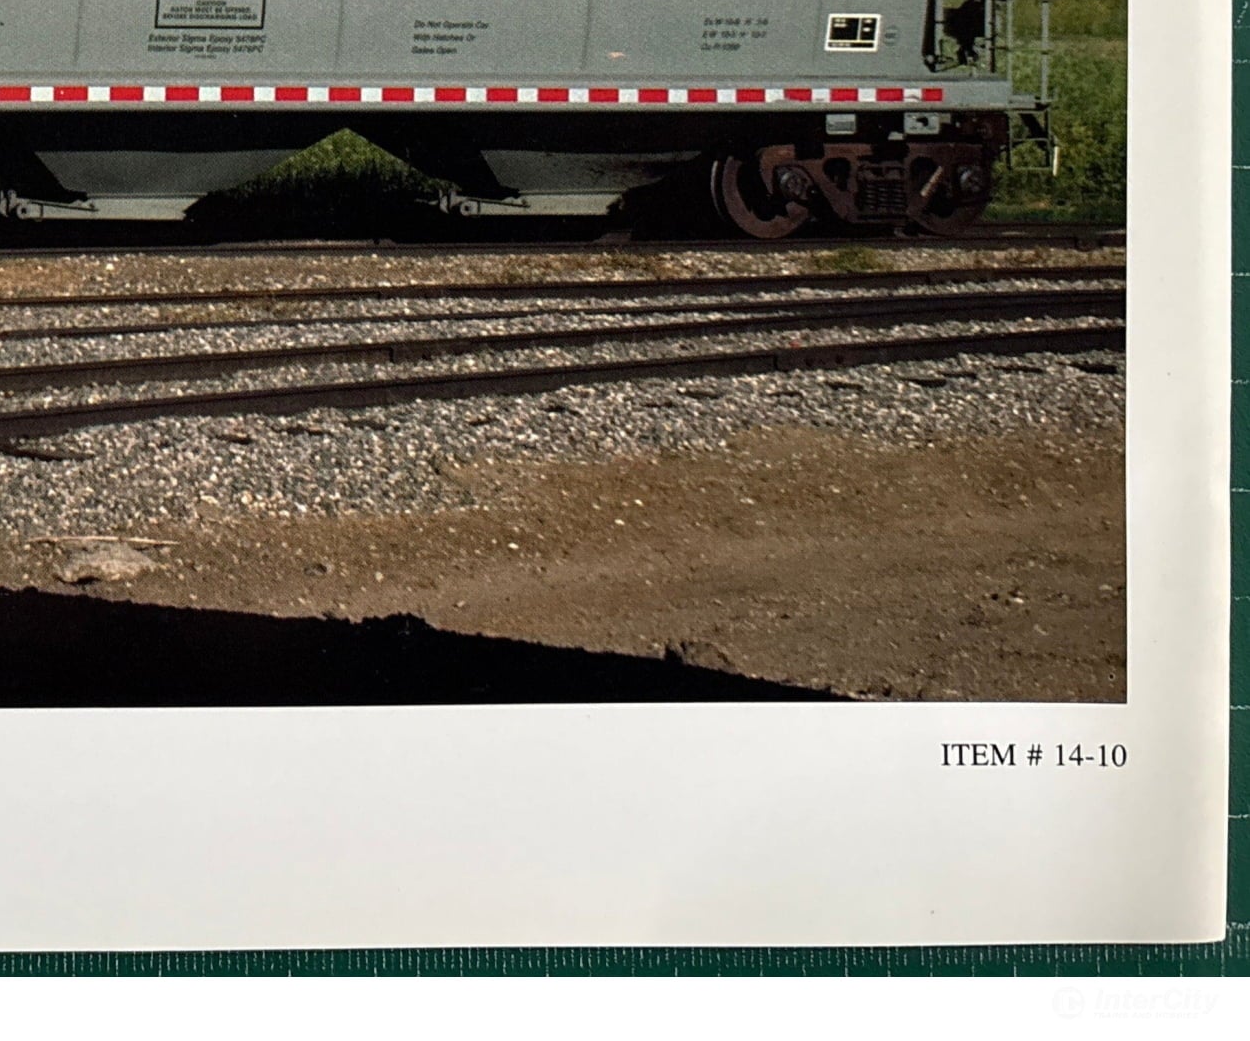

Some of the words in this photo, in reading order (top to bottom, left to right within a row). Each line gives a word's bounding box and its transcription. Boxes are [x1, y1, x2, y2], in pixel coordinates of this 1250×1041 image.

[941, 743, 1017, 766] ITEM
[1027, 743, 1043, 766] #
[1055, 744, 1127, 767] 14-10
